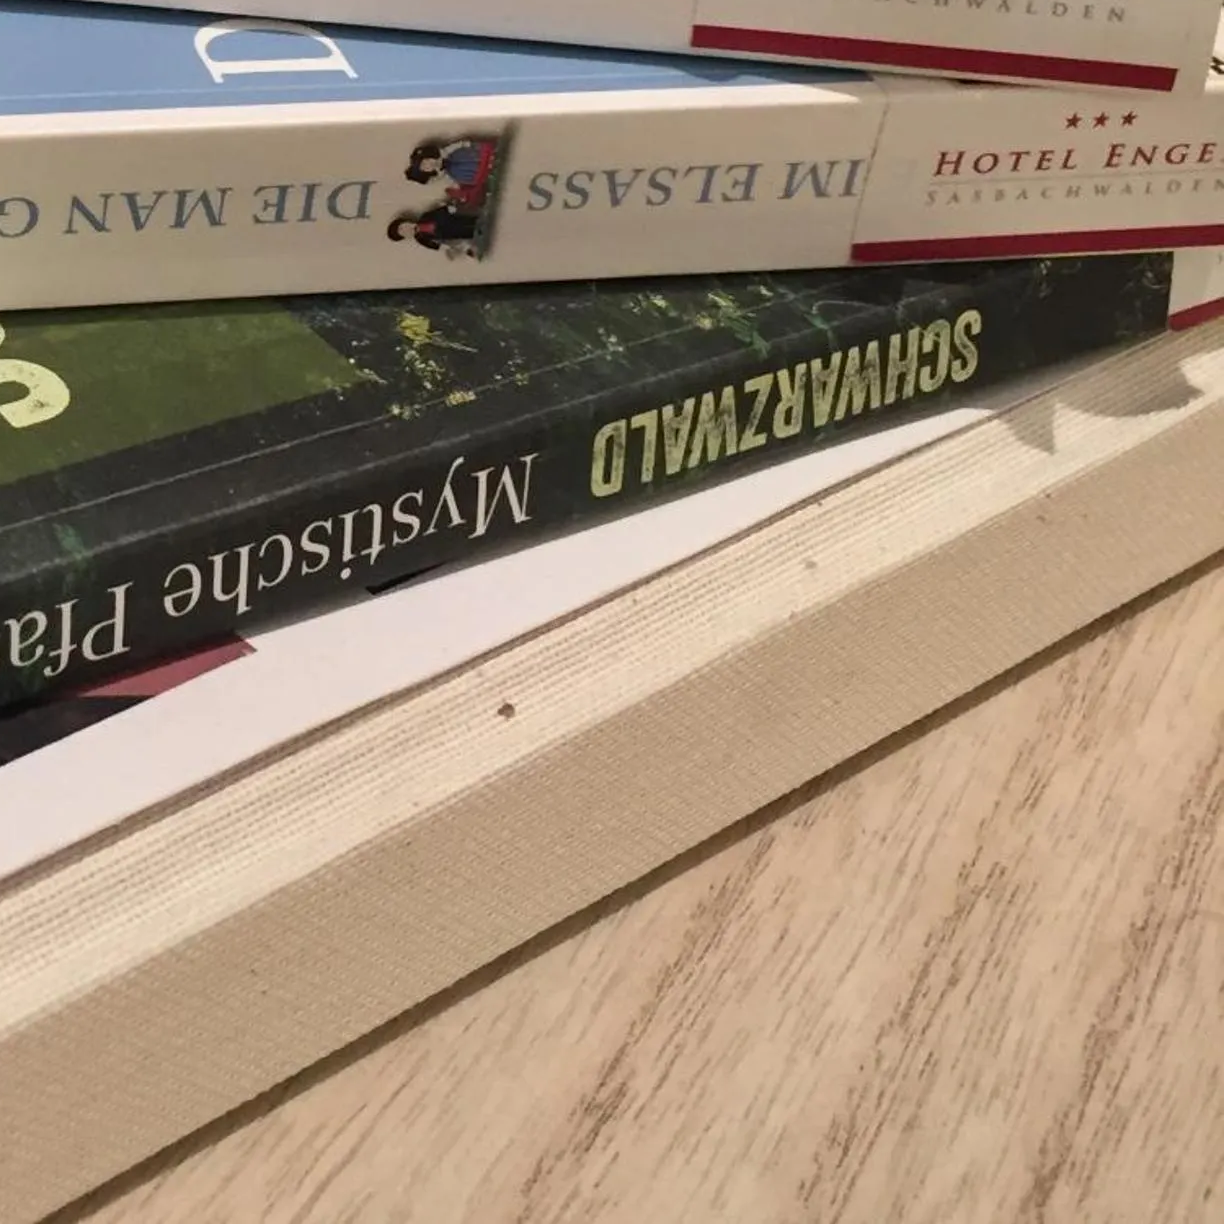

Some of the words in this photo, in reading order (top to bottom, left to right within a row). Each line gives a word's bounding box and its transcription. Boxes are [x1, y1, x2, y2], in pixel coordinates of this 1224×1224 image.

[777, 158, 865, 201] IM
[933, 148, 1078, 177] HOTEL
[1104, 141, 1224, 170] ENGE
[63, 186, 235, 235] MAN
[251, 179, 376, 224] DIE
[525, 161, 763, 213] ELSASS
[589, 308, 982, 501] SCHWARZWALD
[163, 451, 541, 620] Mystische
